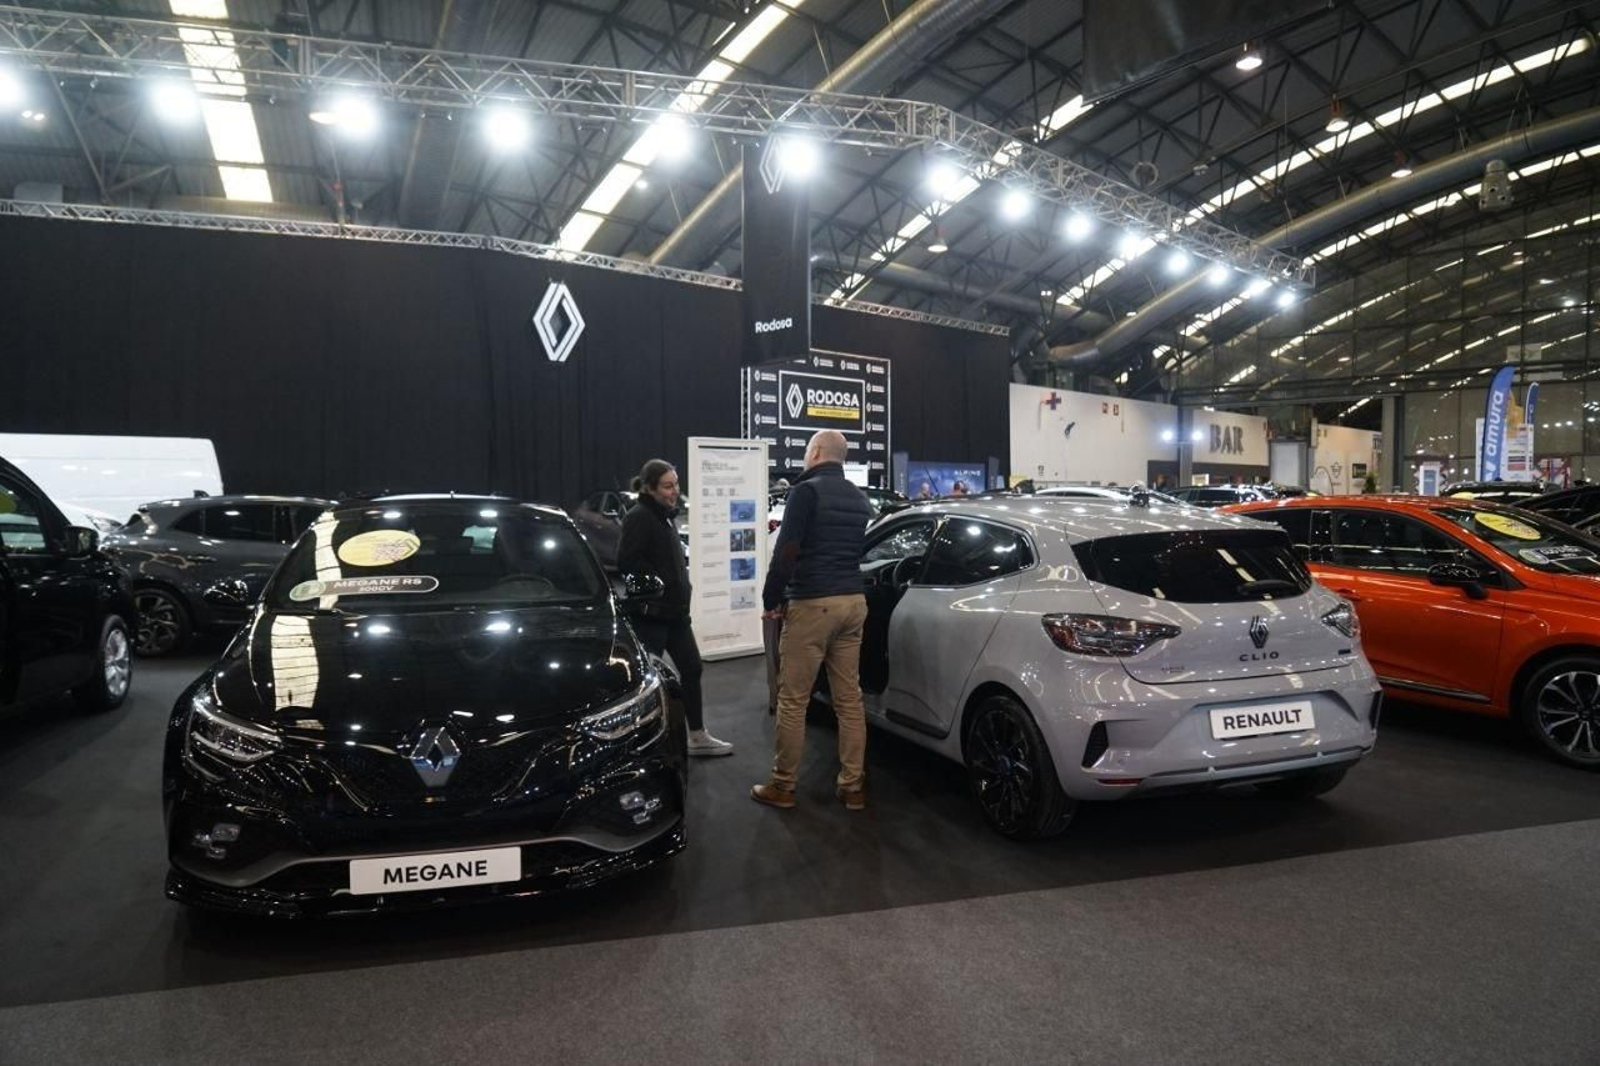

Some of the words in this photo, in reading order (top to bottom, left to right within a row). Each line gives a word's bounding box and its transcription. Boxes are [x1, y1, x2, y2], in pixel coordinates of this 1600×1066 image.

[755, 318, 792, 333] Rodosa
[807, 389, 859, 407] RODOSA
[1486, 390, 1504, 457] amura
[1210, 424, 1243, 454] BAR
[954, 469, 981, 477] ALPINE
[334, 578, 400, 588] MEGANE
[1239, 651, 1279, 662] CLIO
[1223, 709, 1302, 731] RENAULT
[383, 860, 488, 885] MEGANE
